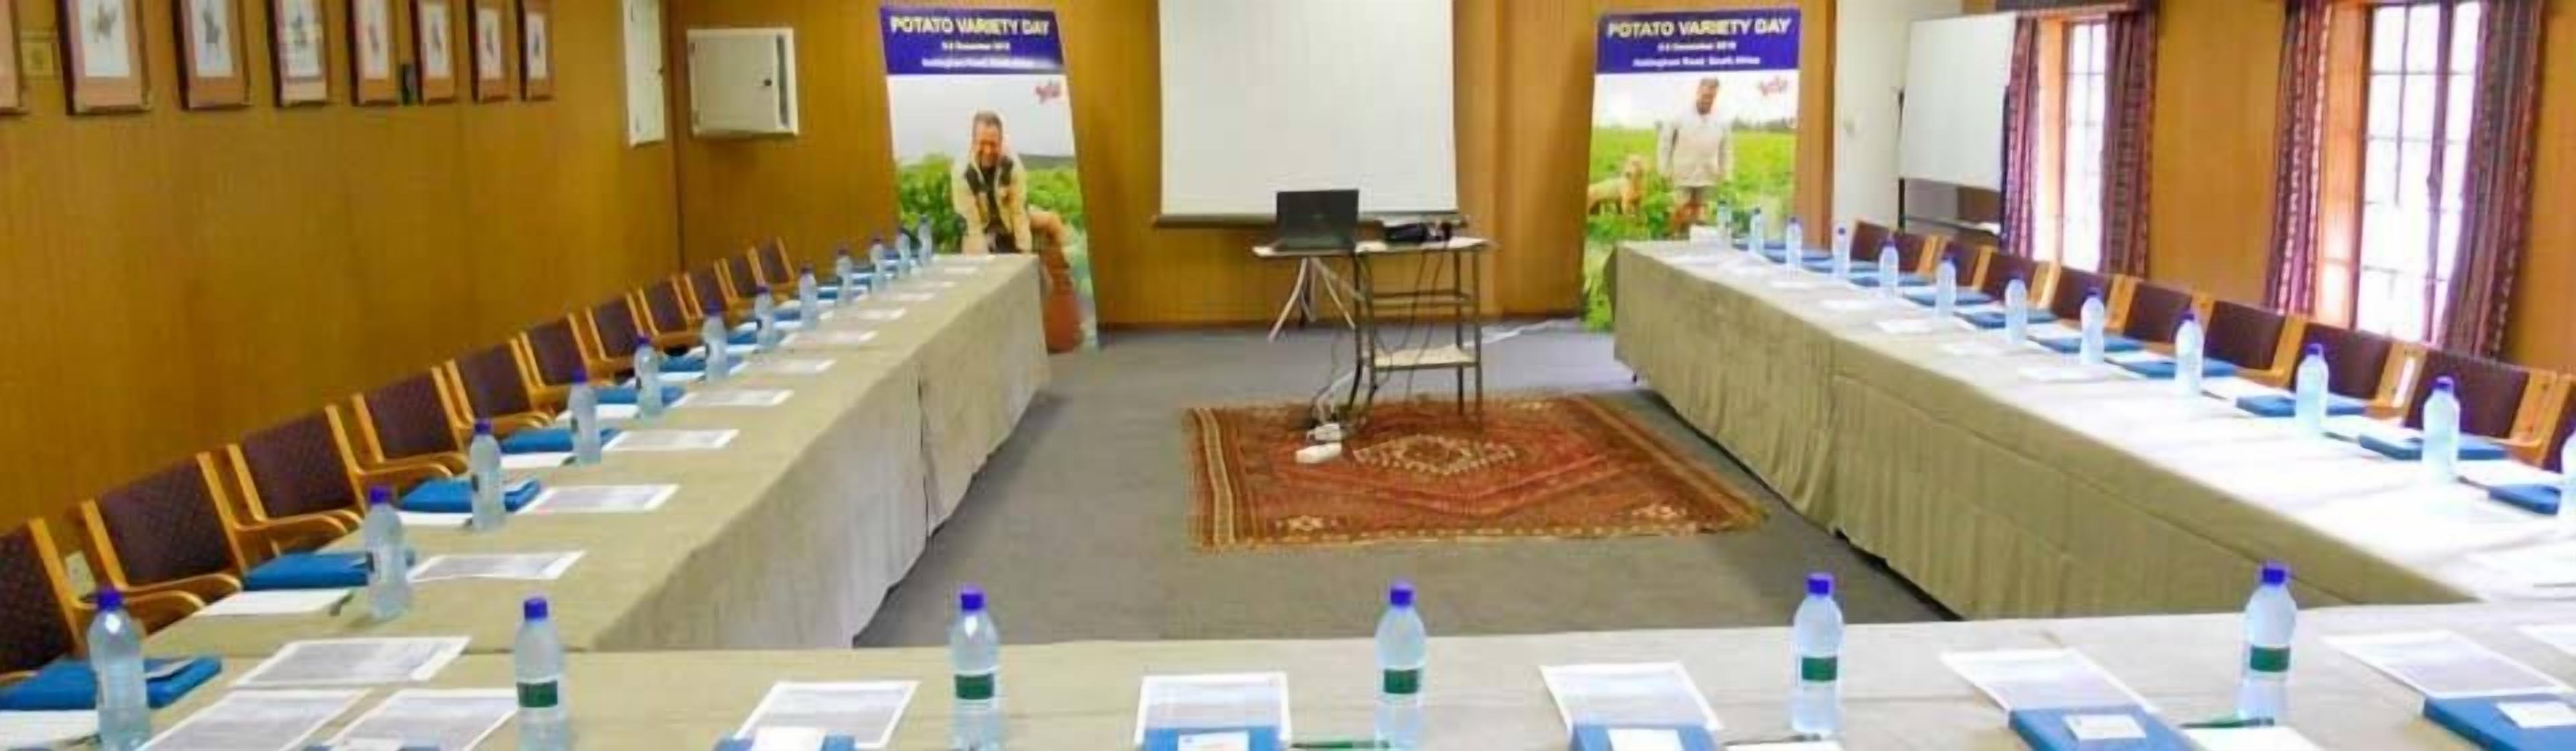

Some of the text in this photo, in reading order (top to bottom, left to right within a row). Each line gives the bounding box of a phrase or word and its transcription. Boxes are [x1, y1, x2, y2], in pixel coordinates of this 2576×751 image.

[891, 16, 1050, 35] POTATO VARIETY DAY
[1608, 17, 1792, 37] POTATO VARIETY DAY
